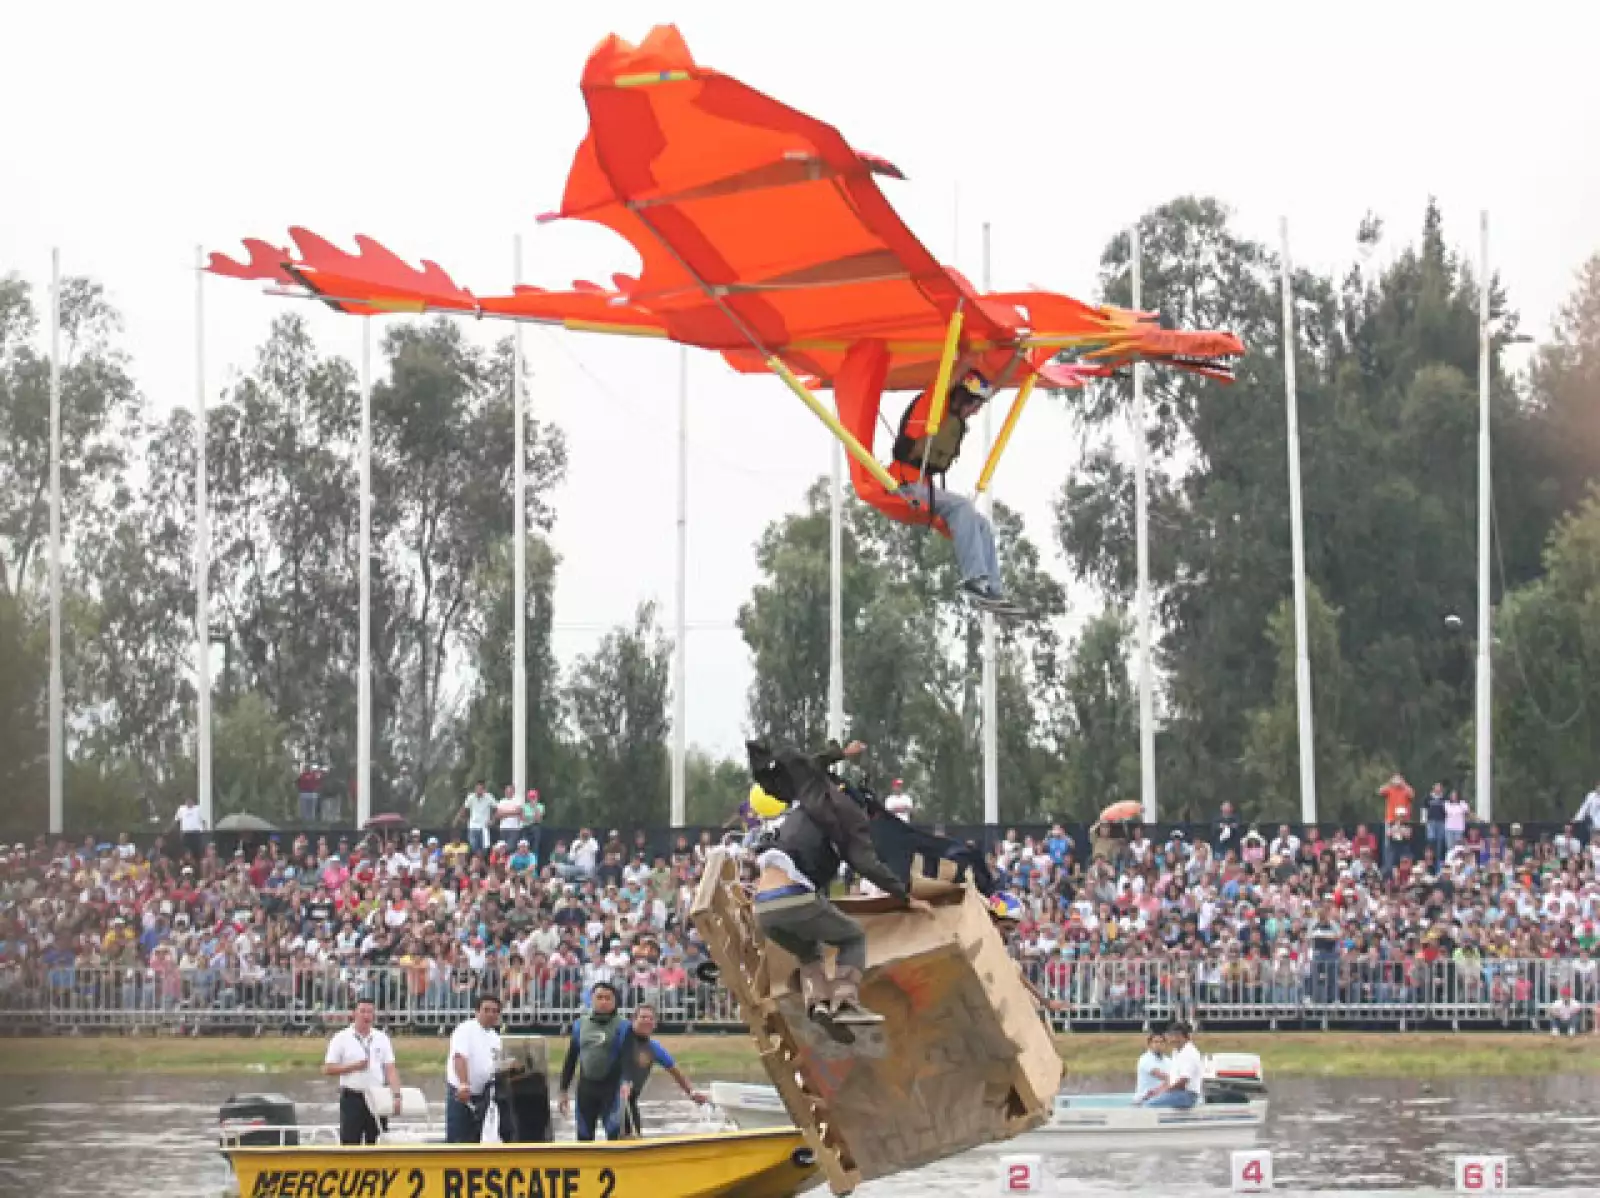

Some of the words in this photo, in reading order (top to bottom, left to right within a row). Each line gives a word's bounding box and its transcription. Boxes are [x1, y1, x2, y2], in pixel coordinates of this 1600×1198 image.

[252, 1168, 399, 1198] MERCURY
[407, 1168, 426, 1198] 2
[444, 1168, 581, 1198] RESCATE
[598, 1168, 616, 1198] 2
[1008, 1164, 1031, 1190] 2
[1242, 1160, 1264, 1184] 4
[1463, 1163, 1484, 1189] 6
